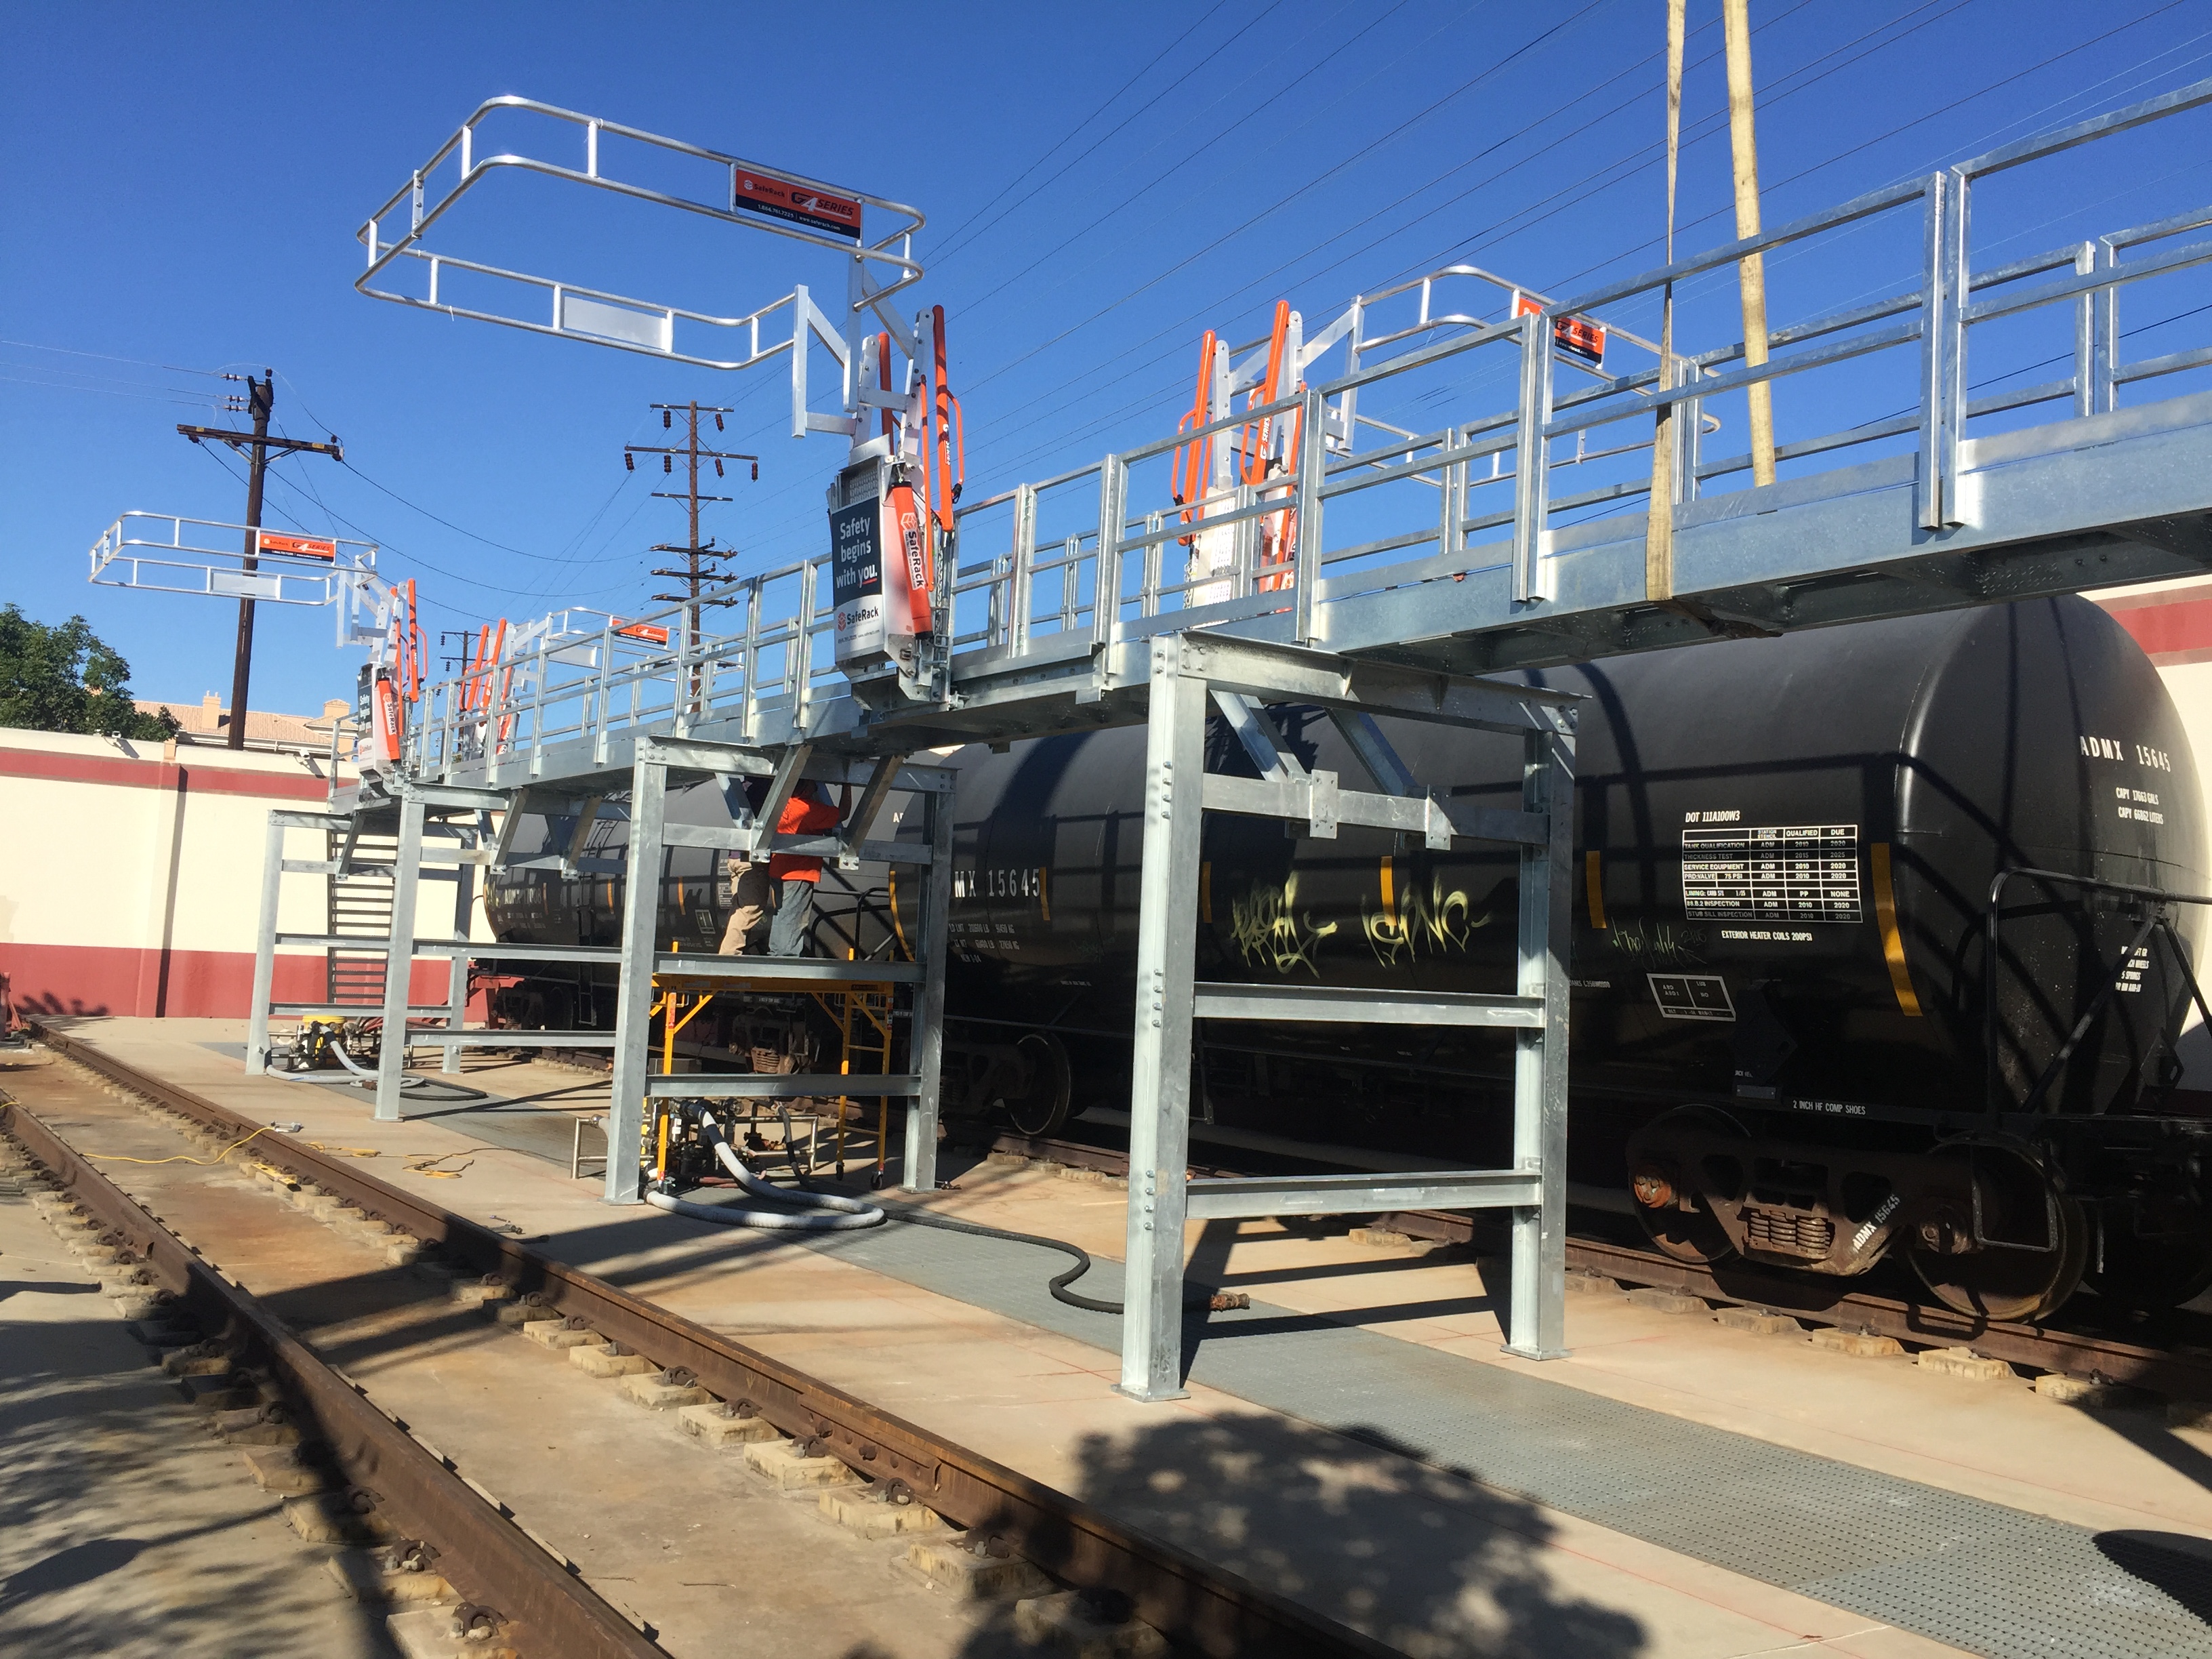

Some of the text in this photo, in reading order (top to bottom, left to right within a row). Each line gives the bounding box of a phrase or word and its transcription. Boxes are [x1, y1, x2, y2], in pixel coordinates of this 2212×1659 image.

[754, 184, 785, 198] SafeRack
[817, 199, 854, 216] SERIES
[1573, 327, 1599, 343] SERIES
[840, 517, 870, 539] Safety
[841, 539, 872, 563] begins
[908, 531, 924, 587] SafeRack
[836, 565, 878, 588] with you.
[847, 607, 879, 625] SafeRack
[2079, 736, 2171, 772] ADMX 15645
[2116, 787, 2130, 800] CAPY
[1685, 810, 1740, 823] DOT 111A100W3
[2118, 806, 2132, 819] CAPY
[954, 868, 1040, 898] MX 15645
[1721, 930, 1813, 941] EXTERIOR HEATER COILS 200PSI
[1793, 1099, 1866, 1115] 2 INCH HF COMP SHOES
[1852, 1193, 1901, 1254] ADMX 15645
